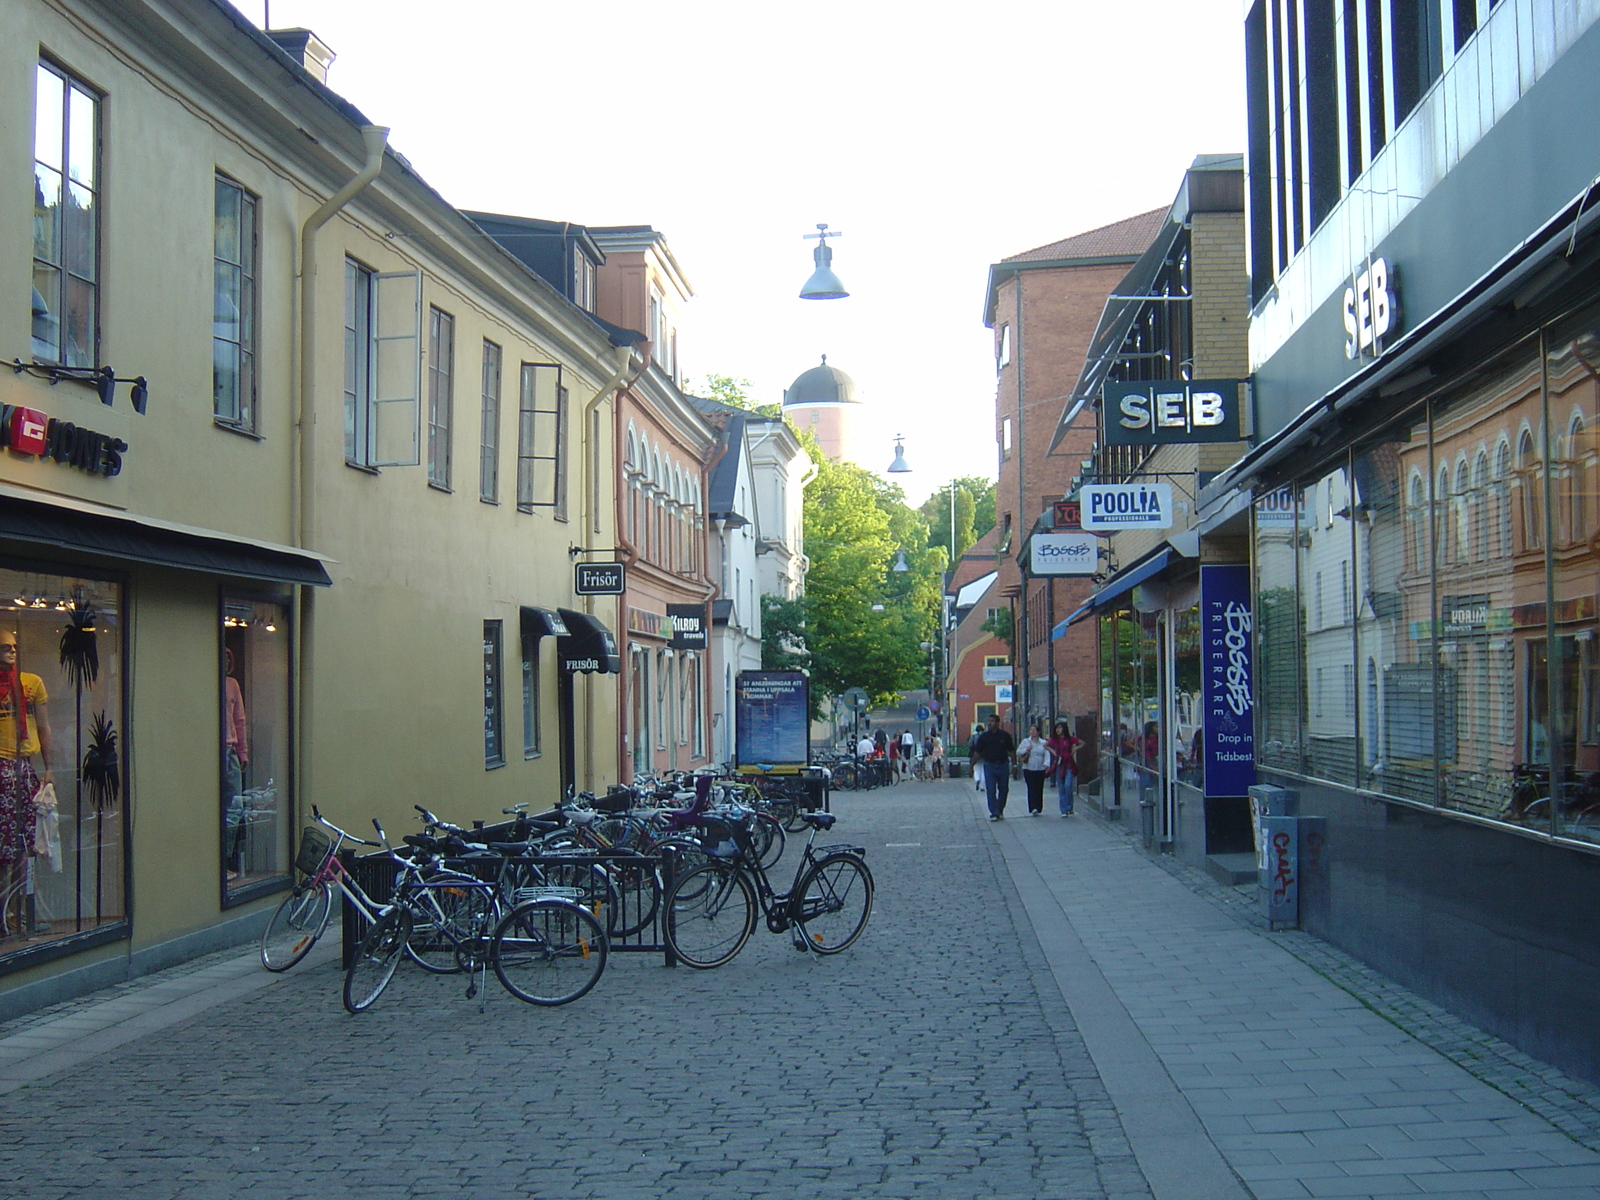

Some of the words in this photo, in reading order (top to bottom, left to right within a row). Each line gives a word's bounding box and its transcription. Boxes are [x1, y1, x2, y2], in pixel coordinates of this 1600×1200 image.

[1343, 257, 1394, 360] SEB
[1119, 390, 1225, 430] SEB
[41, 417, 124, 477] JONES
[583, 570, 618, 587] Frisör
[566, 658, 599, 670] FRISÖR
[1212, 601, 1224, 716] FRISERARE
[1217, 733, 1241, 745] Drop
[1244, 733, 1253, 743] in
